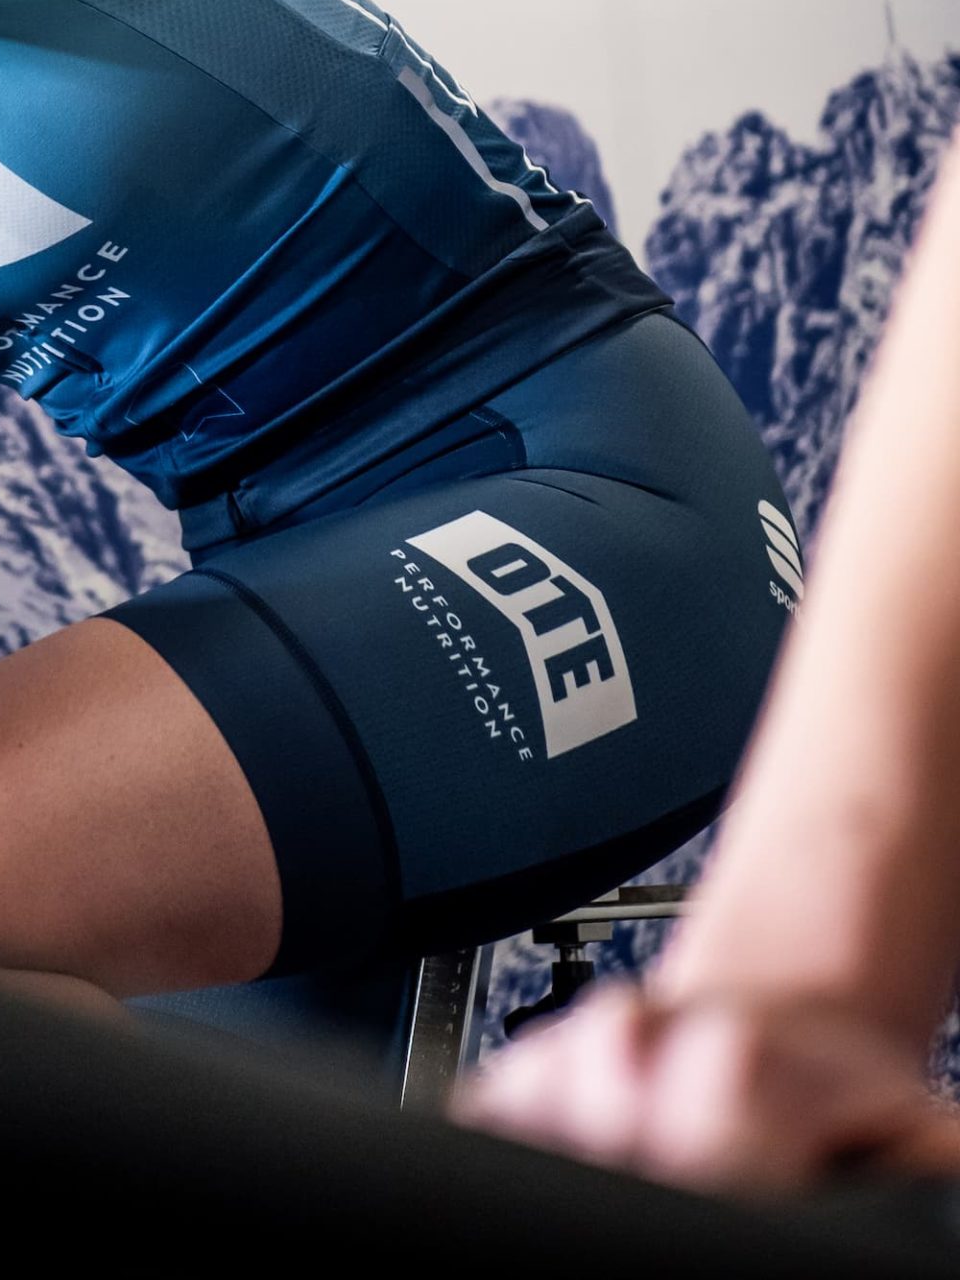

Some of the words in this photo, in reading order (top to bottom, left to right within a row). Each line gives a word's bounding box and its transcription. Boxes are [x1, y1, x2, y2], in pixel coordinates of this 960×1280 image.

[390, 549, 533, 761] PERFORMANCE
[394, 577, 501, 738] NUTRITION
[467, 542, 615, 703] OTE
